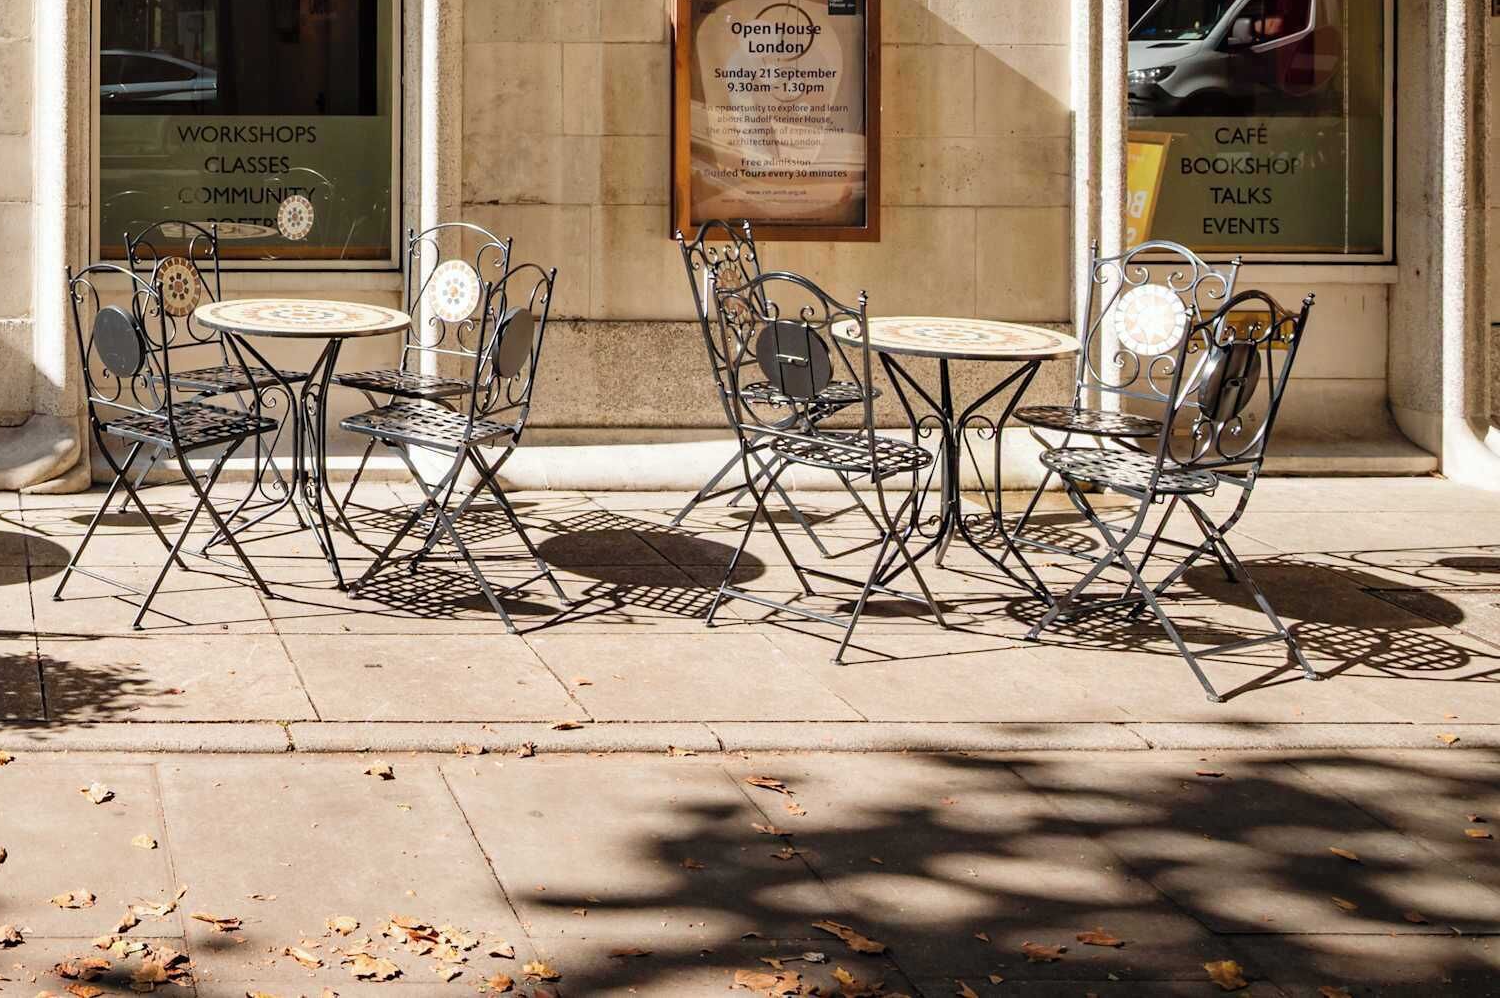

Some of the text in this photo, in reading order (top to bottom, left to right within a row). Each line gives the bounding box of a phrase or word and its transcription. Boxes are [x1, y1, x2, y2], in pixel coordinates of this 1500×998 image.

[731, 22, 822, 38] Open House
[748, 40, 804, 53] London
[714, 67, 837, 81] Sunday 21 September
[727, 83, 771, 93] 9.30am
[783, 82, 824, 95] 1.30pm
[777, 104, 809, 113] explore
[810, 104, 825, 112] and
[827, 104, 849, 112] learn
[744, 115, 772, 123] Rudolf
[773, 115, 804, 123] Steiner
[177, 125, 317, 143] WORKSHOPS
[1215, 123, 1269, 144] CAFÉ
[204, 156, 290, 174] CLASSES
[741, 157, 762, 166] Free
[1181, 157, 1300, 175] BOOKSHOP
[740, 169, 766, 177] Tours
[768, 170, 794, 180] every
[795, 169, 806, 178] 30
[809, 169, 848, 178] minutes
[178, 186, 316, 204] COMMUNITY
[1209, 187, 1273, 204] TALKS
[1202, 217, 1281, 234] EVENTS
